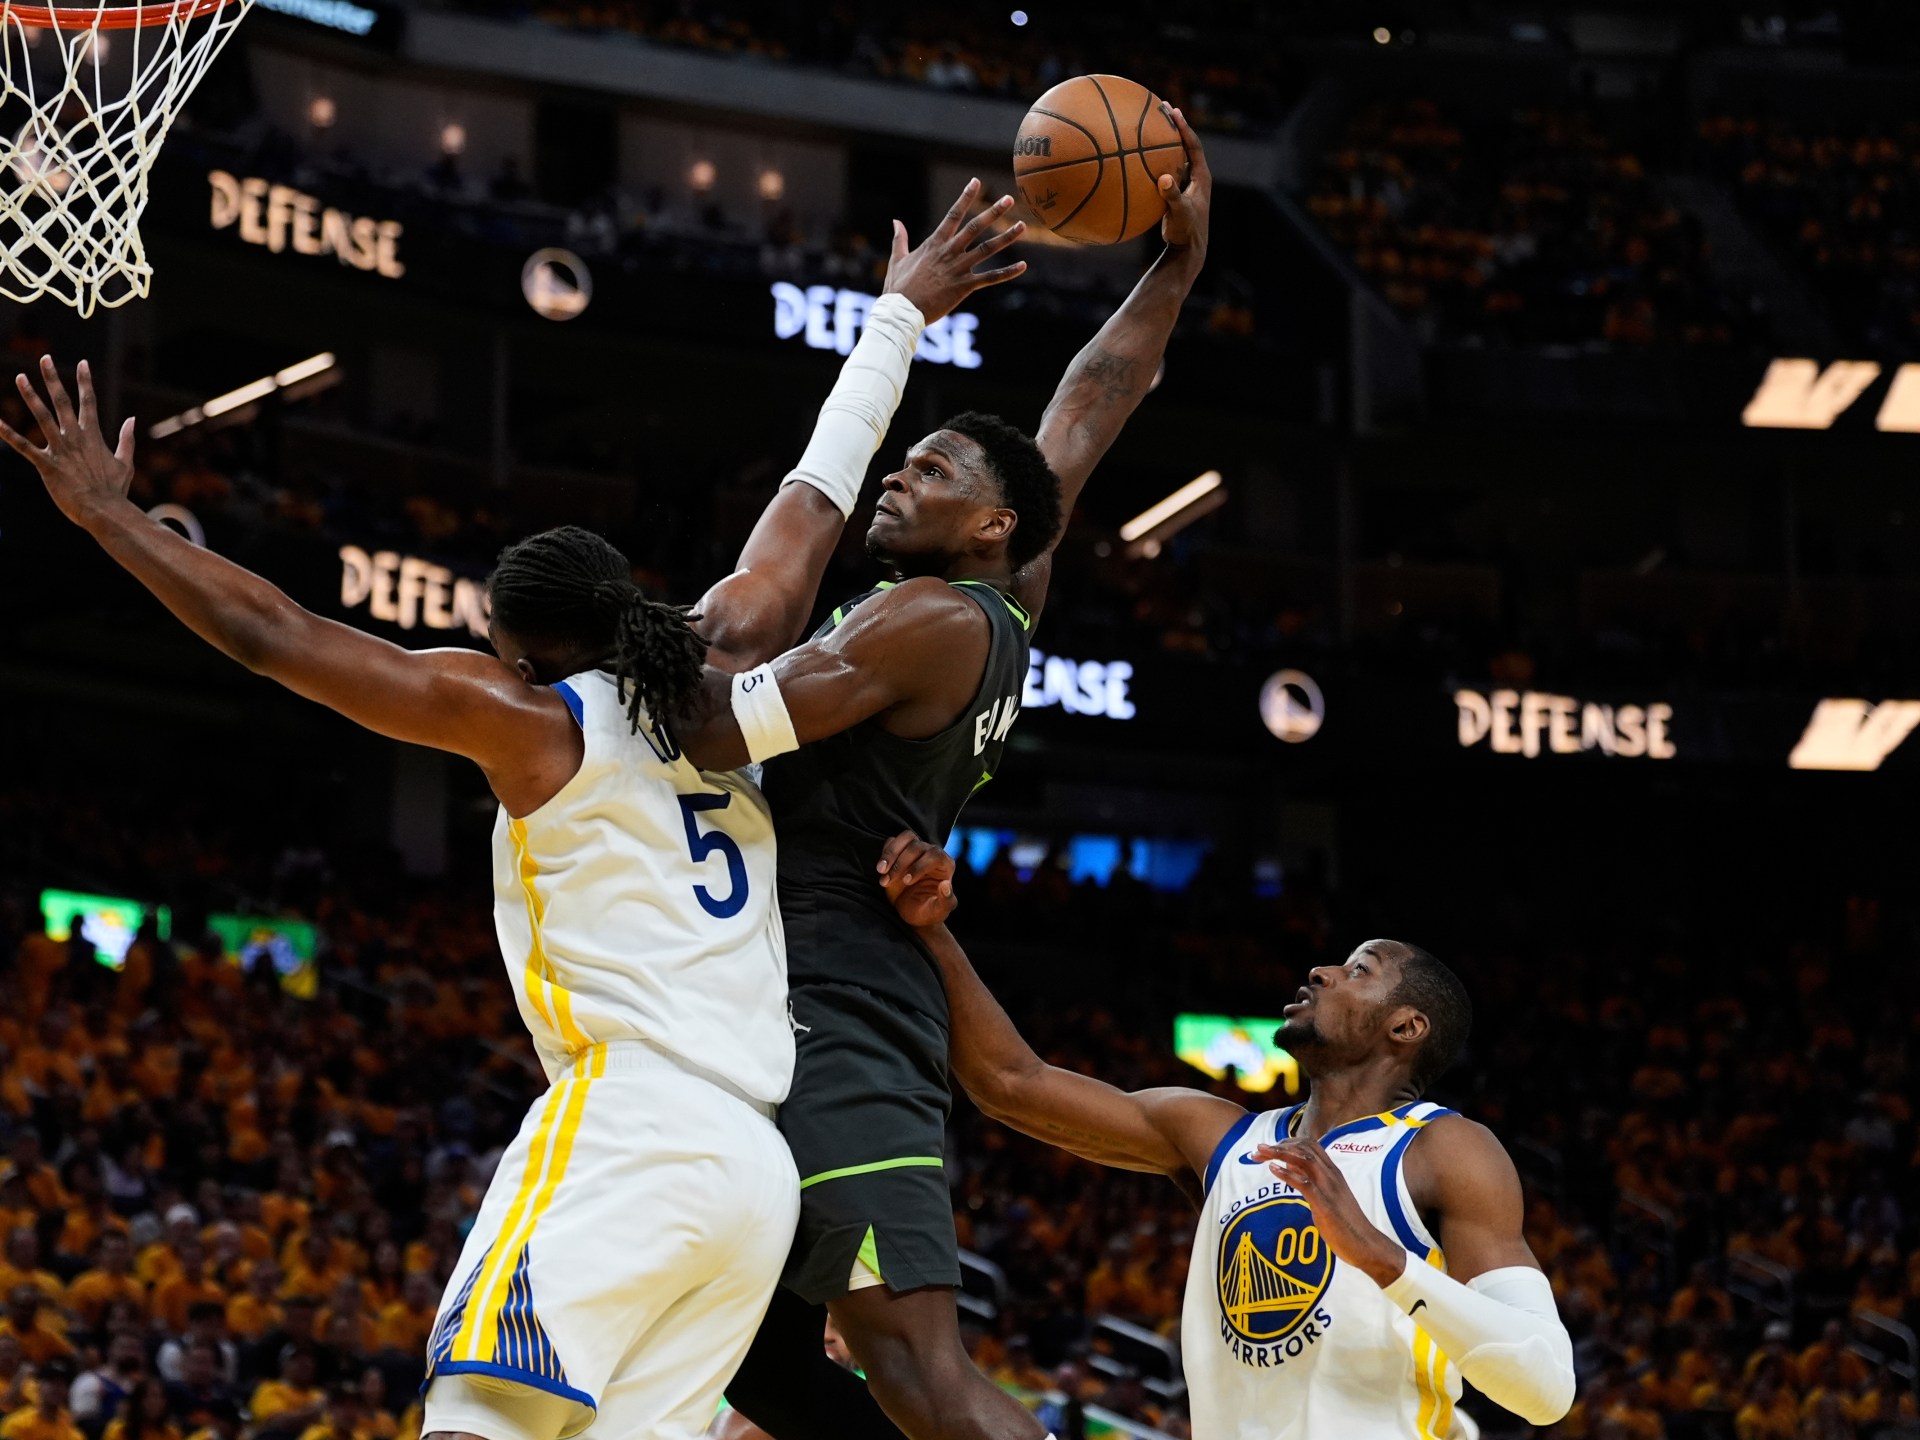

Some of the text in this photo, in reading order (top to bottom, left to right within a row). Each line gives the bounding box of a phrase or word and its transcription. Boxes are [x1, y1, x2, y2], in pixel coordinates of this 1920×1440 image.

[208, 169, 406, 279] DEFENSE
[770, 281, 983, 369] DEFSE
[339, 545, 491, 640] DEFEN
[742, 673, 764, 693] 5
[1021, 647, 1137, 720] ENSE
[1454, 688, 1678, 759] DEFENSE
[677, 791, 749, 919] 5
[1219, 1182, 1295, 1226] GOLDEN
[1275, 1225, 1320, 1267] 00
[1220, 1306, 1332, 1368] WARRIORS
